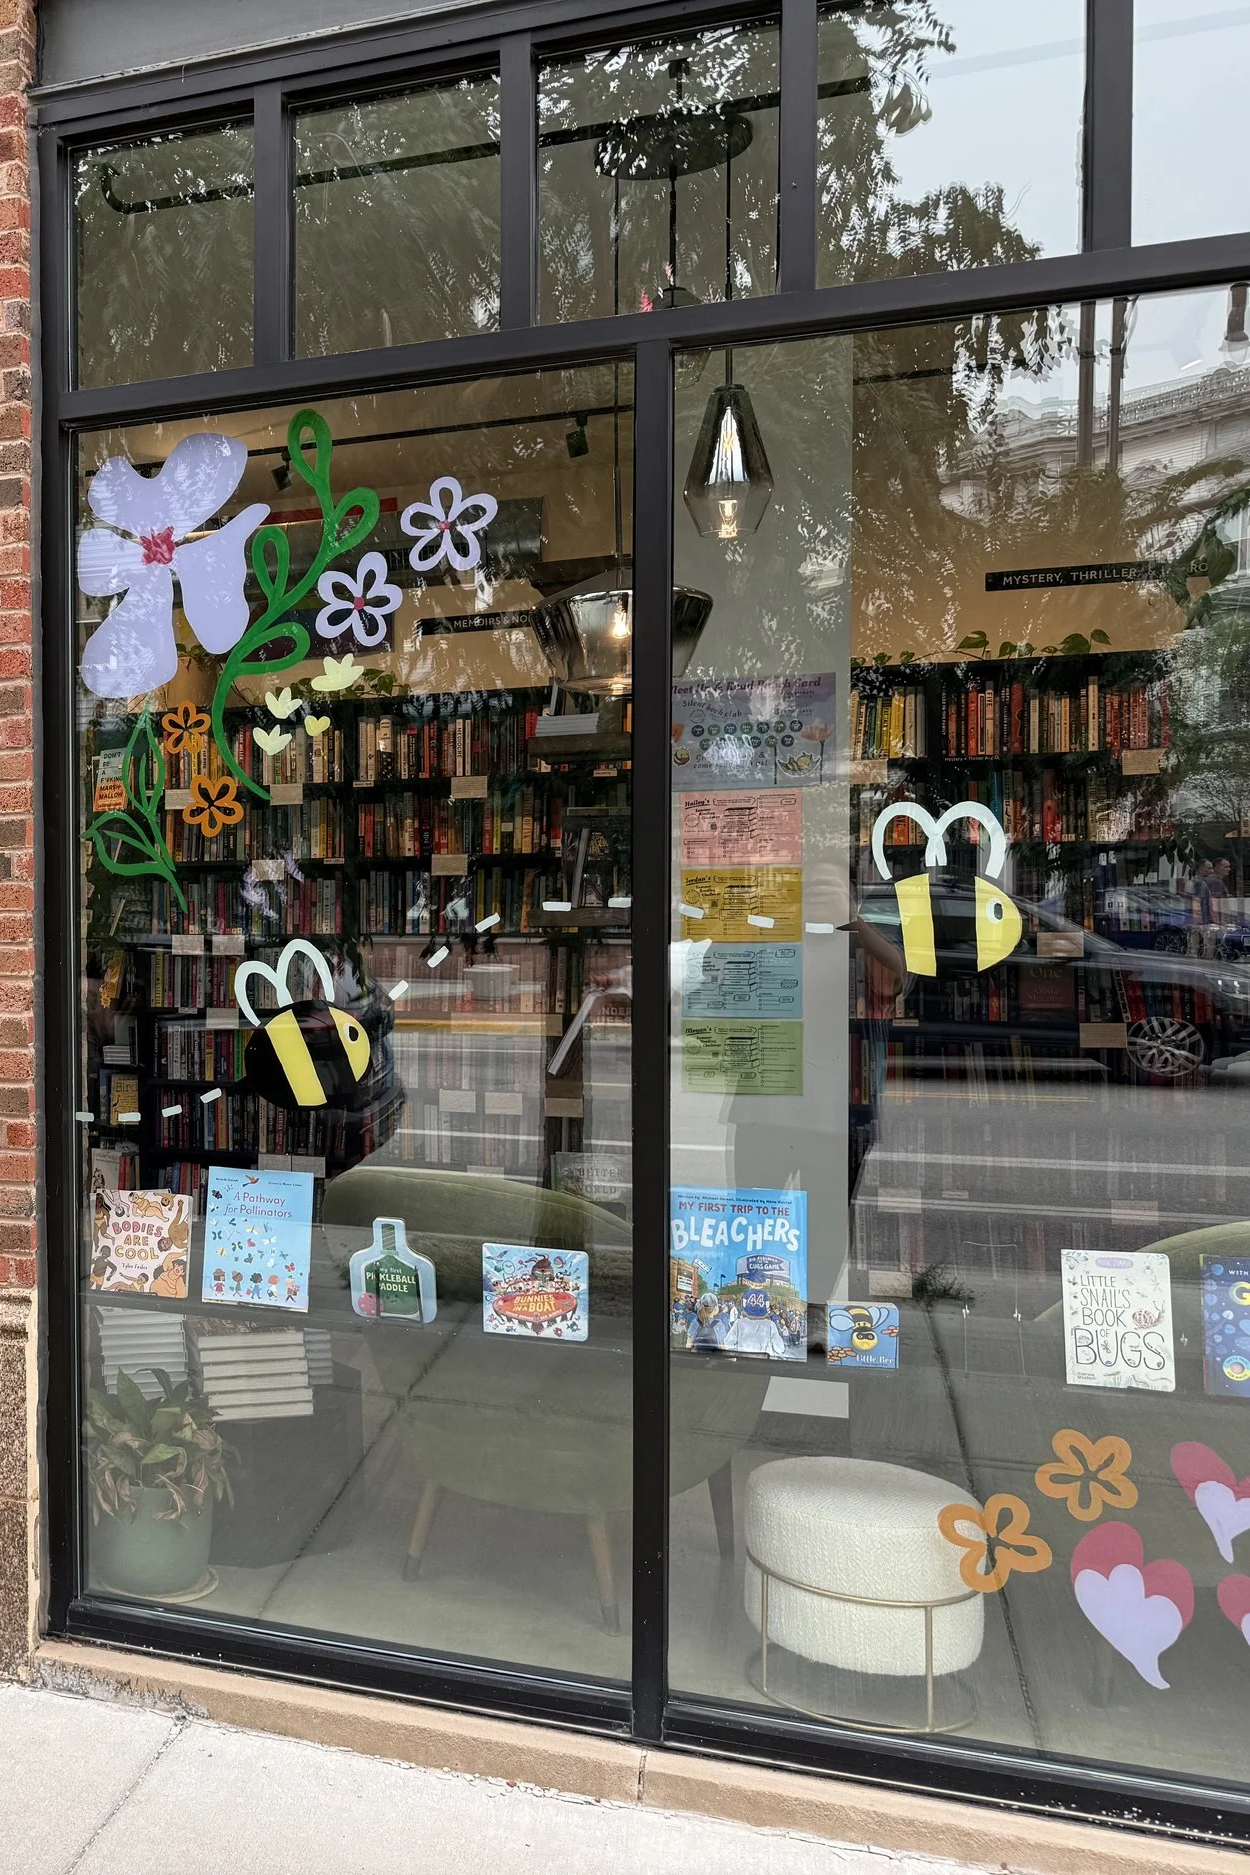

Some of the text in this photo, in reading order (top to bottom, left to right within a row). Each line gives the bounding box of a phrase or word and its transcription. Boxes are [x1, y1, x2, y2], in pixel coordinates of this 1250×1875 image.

[1003, 572, 1064, 586] MYSTERY,
[1070, 568, 1137, 582] THRILLER
[454, 616, 501, 628] MEMOIRS
[574, 1185, 617, 1195] WORLD
[233, 1191, 286, 1207] A Pathway
[223, 1203, 293, 1218] for Pollinators
[678, 1201, 790, 1216] MY FIRST TRIP TO THE
[112, 1220, 163, 1238] BODIES
[671, 1215, 800, 1252] BLEACHERS
[123, 1234, 149, 1246] ARE
[115, 1245, 159, 1260] COOL
[366, 1272, 416, 1284] PIKLEBALL
[1080, 1275, 1116, 1288] LITTLE
[379, 1283, 409, 1293] ADDLE
[514, 1294, 555, 1304] BUNNIES
[748, 1293, 765, 1306] 44
[1080, 1288, 1131, 1309] SNAIL'S
[528, 1301, 556, 1312] BOAT
[1082, 1307, 1127, 1328] BOOK
[1100, 1328, 1111, 1338] OF
[1074, 1328, 1166, 1371] BUGS
[856, 1354, 877, 1364] Little
